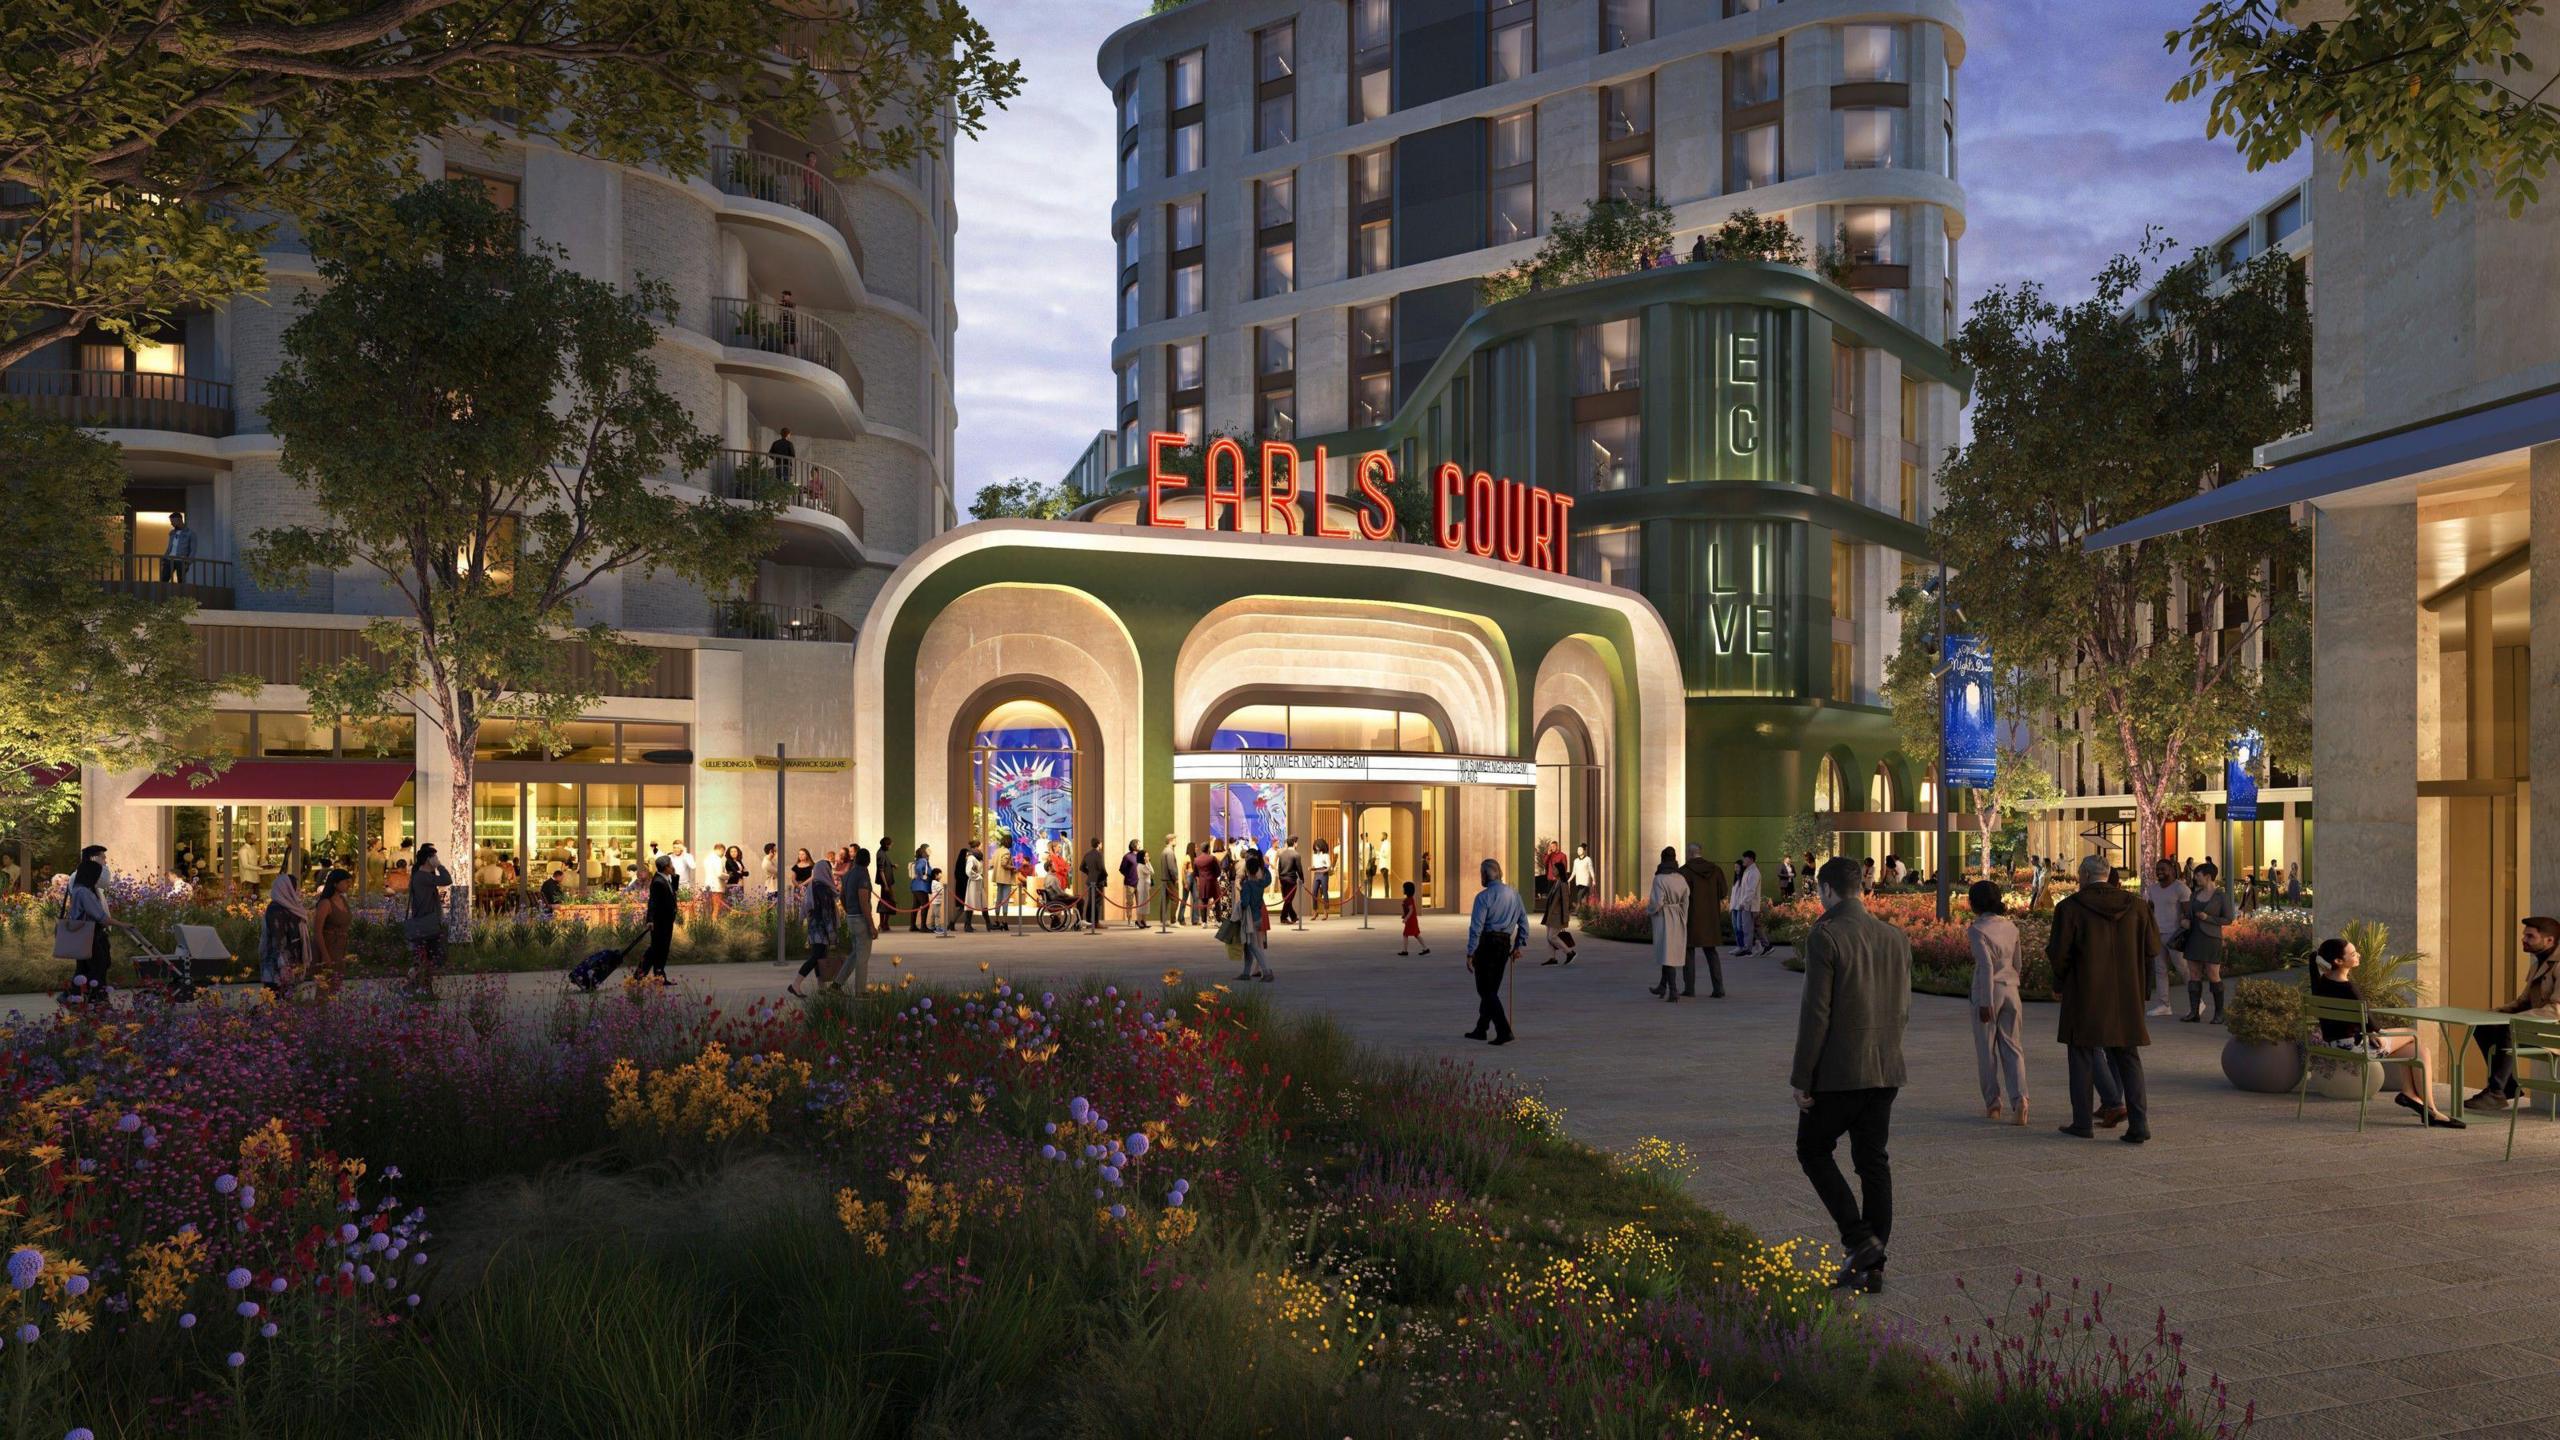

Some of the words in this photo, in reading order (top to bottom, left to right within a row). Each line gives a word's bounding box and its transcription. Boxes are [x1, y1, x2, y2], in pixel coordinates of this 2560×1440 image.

[1147, 431, 1396, 541] EARLS
[1433, 461, 1575, 575] COURT
[786, 760, 818, 768] WARWICK
[820, 760, 847, 768] SQUARE
[1245, 754, 1260, 767] MID
[1263, 755, 1300, 768] SUMMER
[1302, 755, 1334, 768] NIGHT'S
[1336, 756, 1366, 769] DREAM
[1245, 767, 1264, 779] AUG
[1266, 767, 1275, 779] 20
